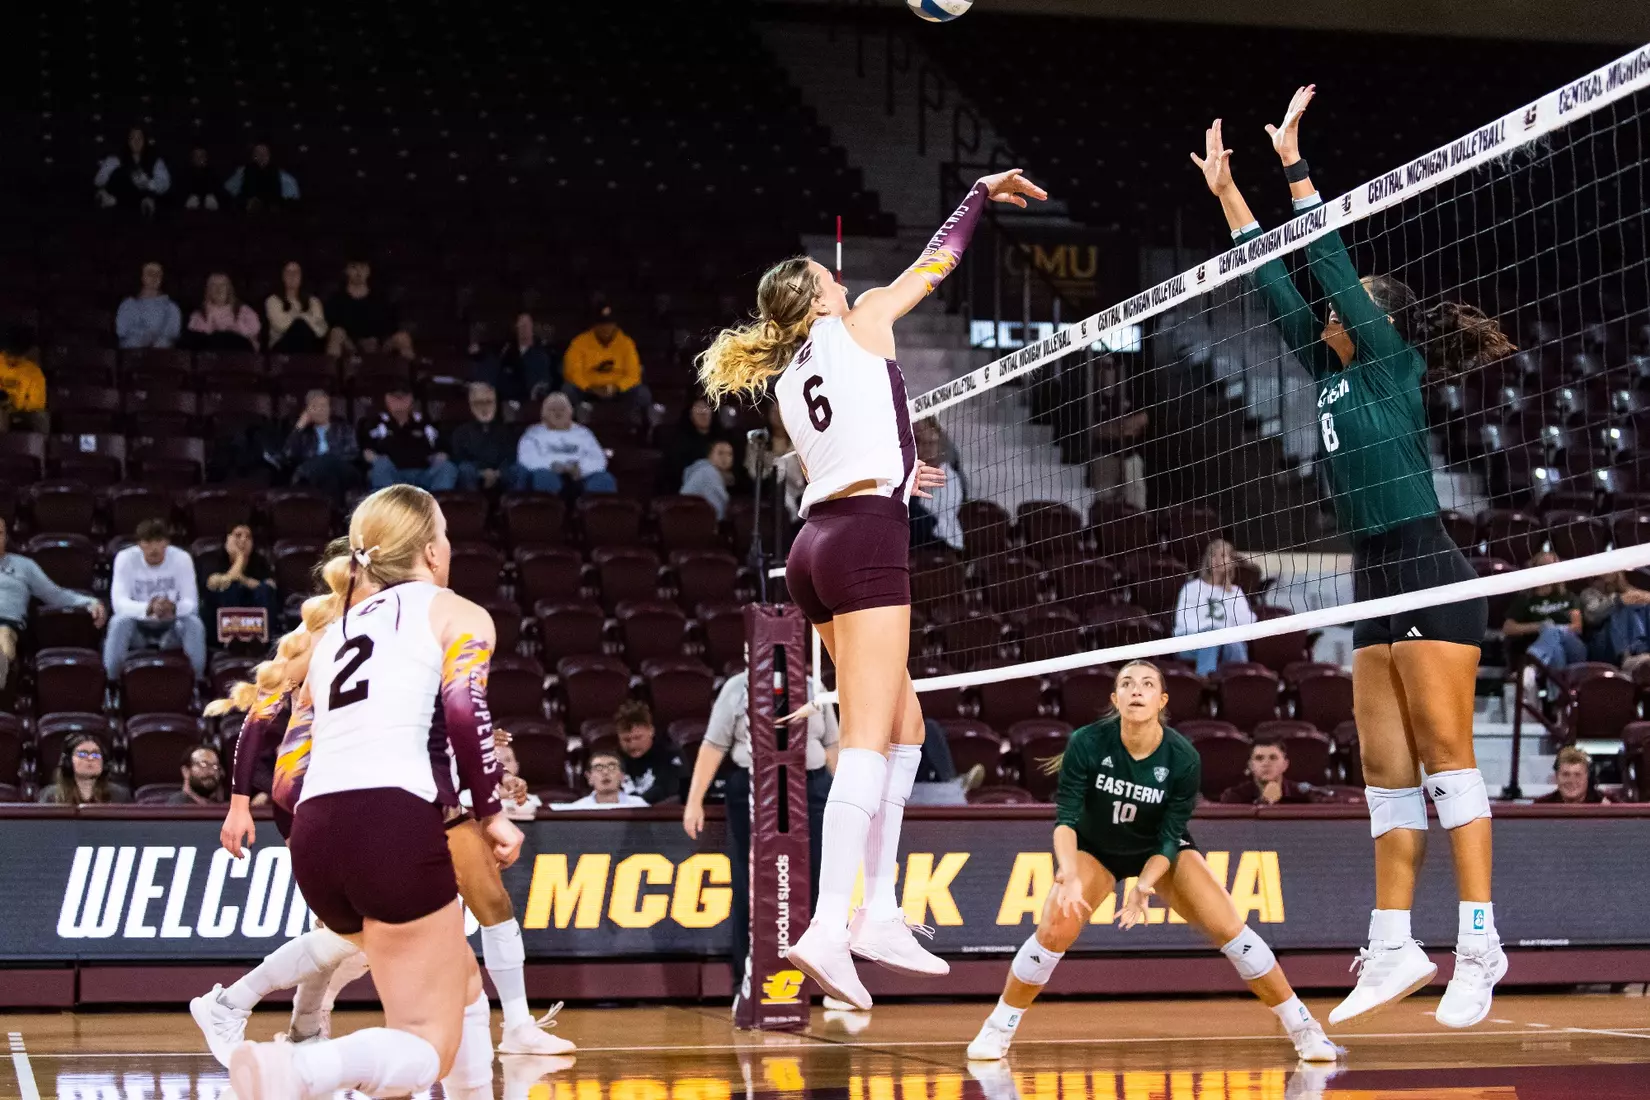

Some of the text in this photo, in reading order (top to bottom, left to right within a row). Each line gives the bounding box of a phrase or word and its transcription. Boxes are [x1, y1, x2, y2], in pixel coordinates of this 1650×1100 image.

[1558, 74, 1603, 115] CENTRAL
[1367, 119, 1506, 204] CENTRAL MICHIGAN VOLLEYBALL
[1003, 243, 1099, 279] CMU
[1218, 204, 1328, 276] CENTRAL MICHIGAN VOLLEYBALL
[1097, 304, 1122, 332] CENTRAL
[1151, 273, 1186, 308] VOLLEYBALL
[802, 374, 833, 433] 6
[1321, 412, 1340, 453] 8
[328, 633, 375, 712] 2
[1095, 773, 1165, 804] EASTERN
[1112, 800, 1138, 825] 10
[774, 853, 791, 900] sports
